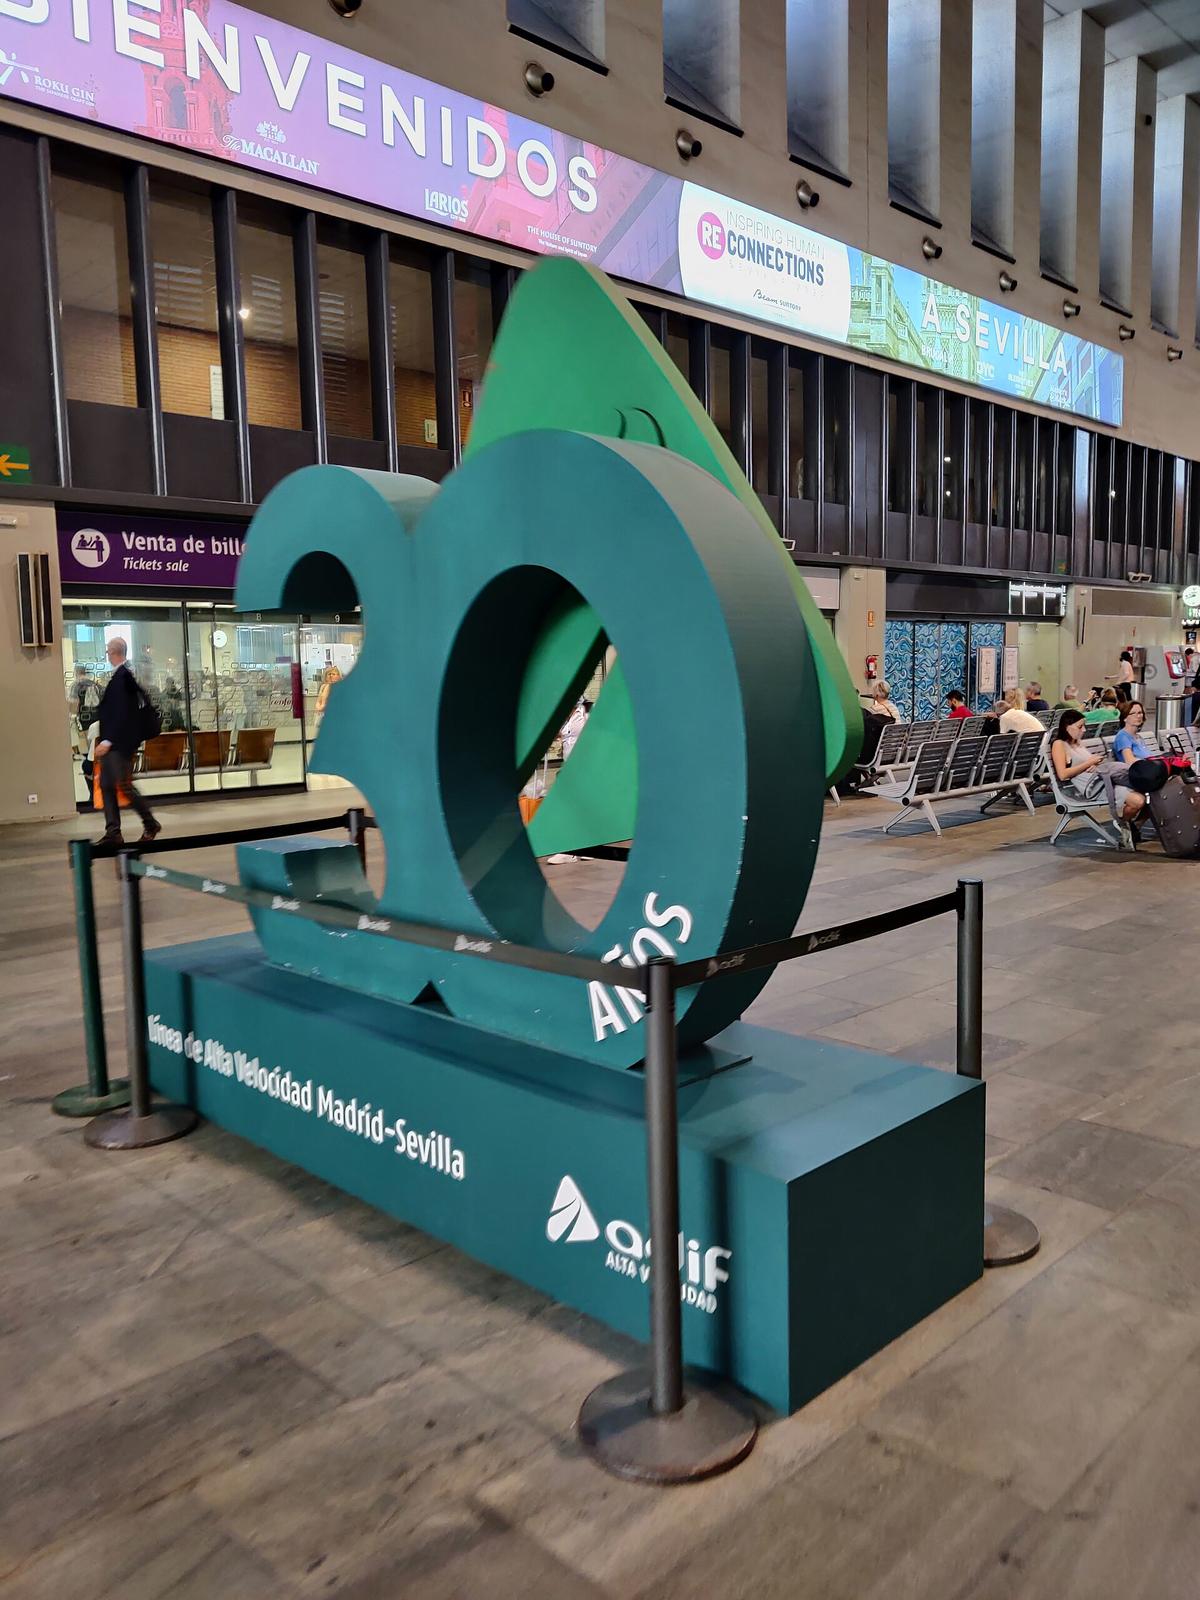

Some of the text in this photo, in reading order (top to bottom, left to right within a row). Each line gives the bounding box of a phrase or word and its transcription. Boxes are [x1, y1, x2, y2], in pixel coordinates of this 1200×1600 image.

[35, 76, 70, 94] ROKU
[71, 87, 95, 102] GIN
[0, 0, 598, 213] IENVENIDOS
[240, 139, 320, 176] MACALLAN
[424, 188, 470, 219] LARIOS
[527, 225, 540, 236] THE
[540, 229, 561, 243] HOUSE
[561, 236, 572, 247] OF
[701, 221, 722, 251] RE
[726, 210, 825, 260] INSPIRING HUMAN
[727, 229, 825, 287] CONNECTIONS
[753, 288, 778, 304] Beam
[920, 293, 1068, 377] A SEVILLA
[121, 531, 177, 553] Venta
[183, 534, 205, 554] de
[122, 557, 189, 572] Tickets sale
[334, 613, 342, 624] 9
[183, 1031, 205, 1065] de
[233, 1050, 313, 1113] Velocidad
[317, 1084, 467, 1181] Madrid-Sevilla
[604, 1249, 638, 1280] ALTA
[605, 1219, 733, 1293] aif
